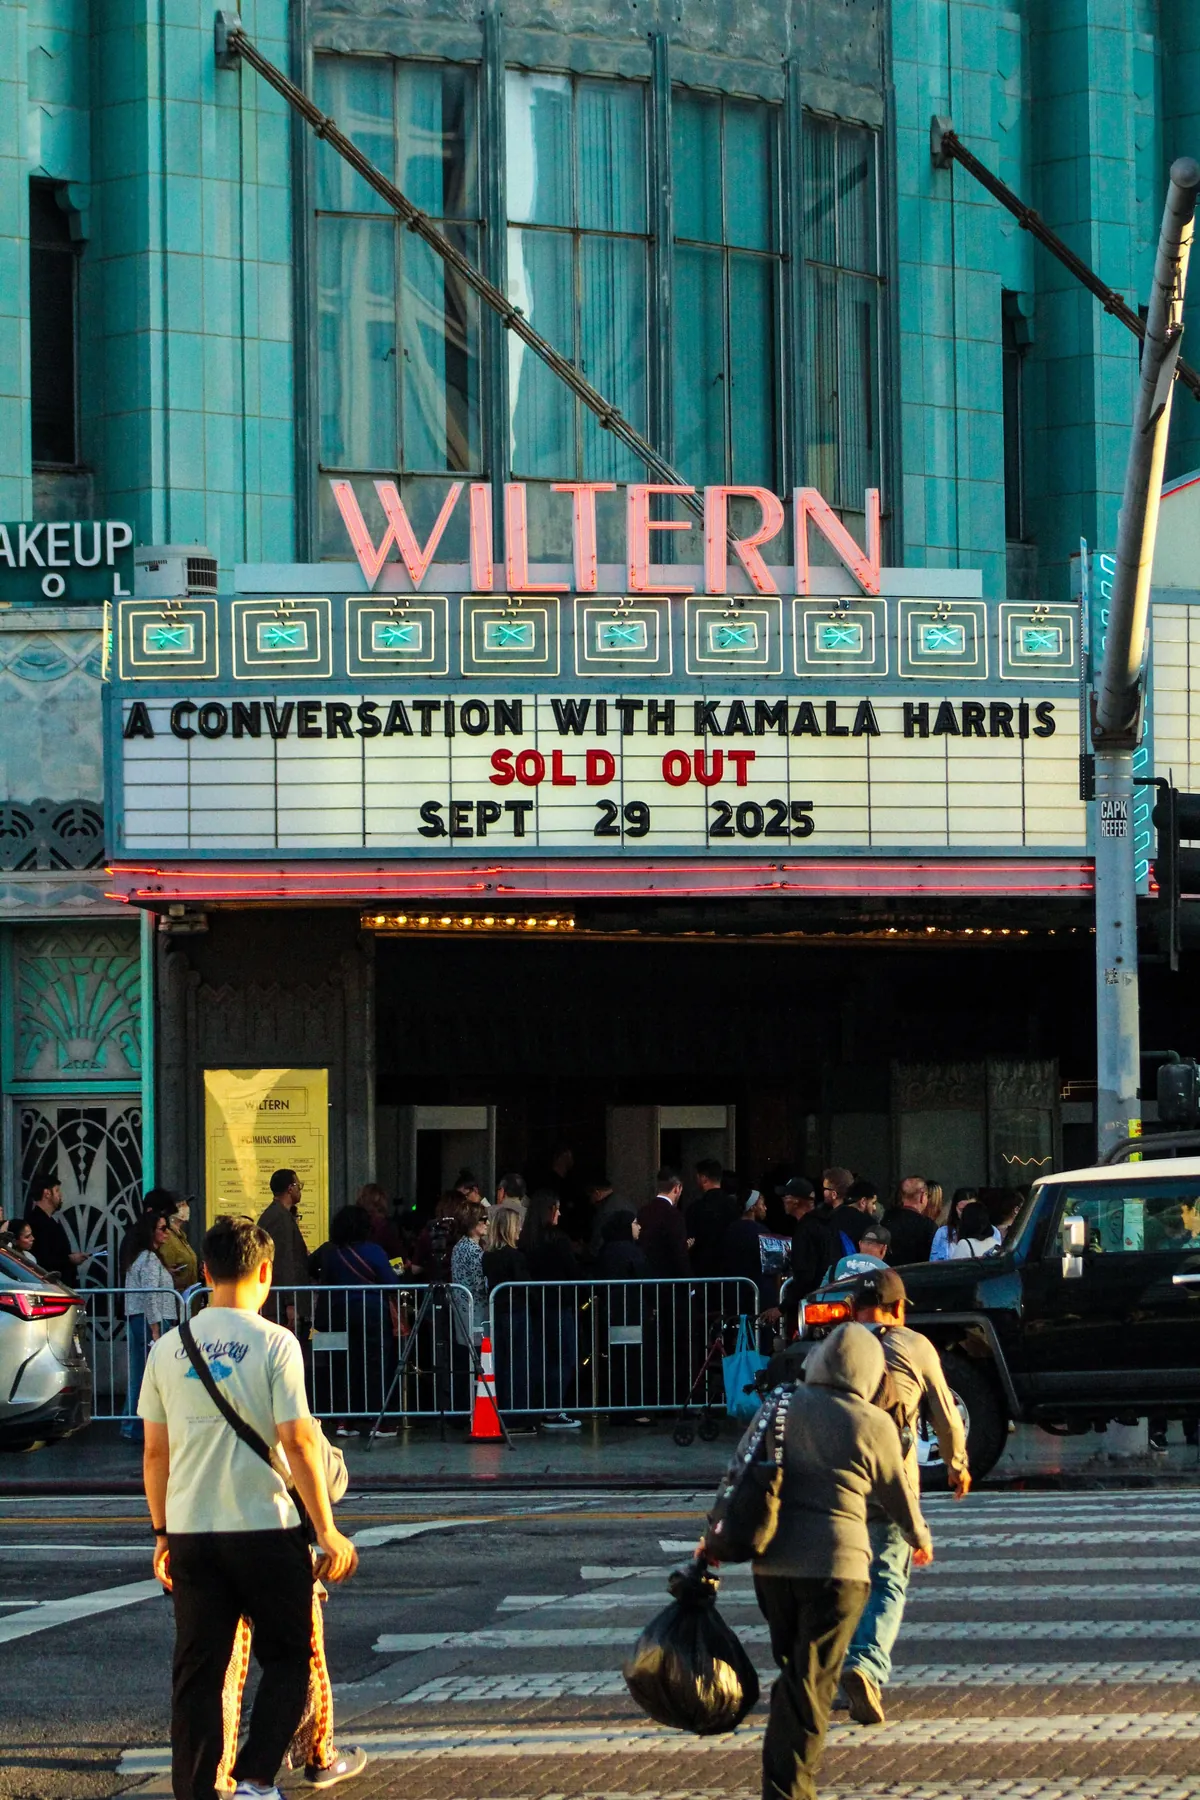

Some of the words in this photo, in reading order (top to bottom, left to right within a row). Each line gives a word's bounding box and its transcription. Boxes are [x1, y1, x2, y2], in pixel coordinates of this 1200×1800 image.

[0, 521, 133, 568] AKEUP
[329, 479, 881, 596] WILTERN
[122, 701, 155, 739] A
[169, 699, 524, 739] CONVERSATION
[551, 699, 675, 737] WITH
[694, 699, 881, 737] KAMALA
[903, 700, 1057, 739] HARRIS
[489, 749, 616, 787] SOLD
[662, 749, 756, 787] OUT
[418, 800, 534, 838] SEPT
[593, 800, 651, 838] 29
[709, 799, 815, 838] 2025
[1101, 801, 1127, 819] CAPK
[1101, 820, 1128, 837] REEFER
[245, 1099, 290, 1111] WLTERN
[238, 1135, 272, 1145] PCOMING
[273, 1135, 297, 1145] SHOWS
[174, 1339, 250, 1363] ueberry
